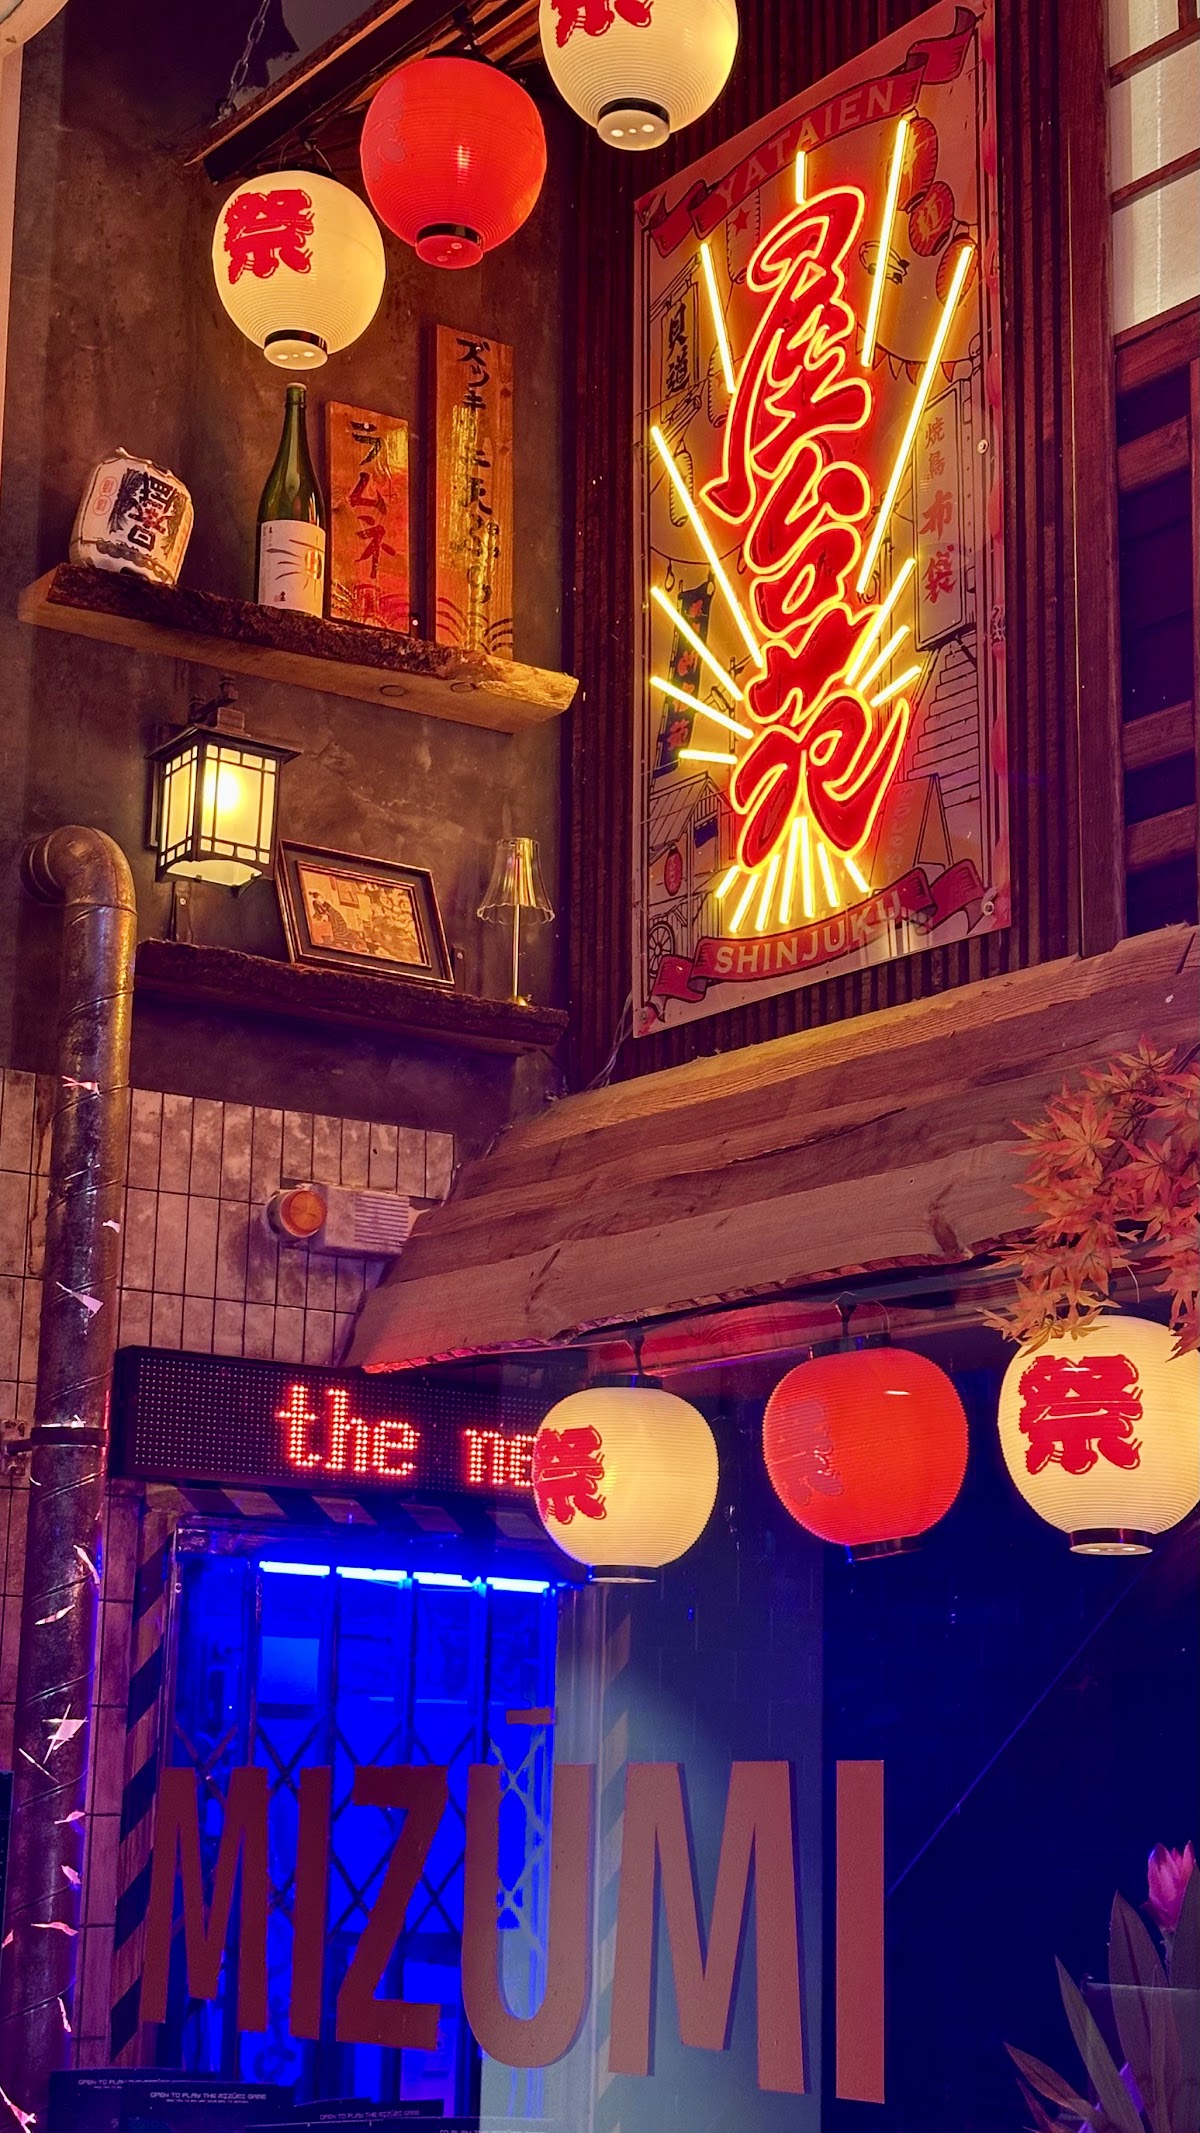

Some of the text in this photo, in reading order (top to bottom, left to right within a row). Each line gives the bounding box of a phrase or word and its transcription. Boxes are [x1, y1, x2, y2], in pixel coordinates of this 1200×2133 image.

[715, 80, 895, 206] YATAIEN
[223, 188, 315, 285] 祭
[349, 420, 397, 580] ラムネ
[714, 889, 902, 975] SHINJUKU
[276, 1384, 421, 1477] the
[1018, 1354, 1144, 1475] 祭
[534, 1424, 607, 1525] 祭
